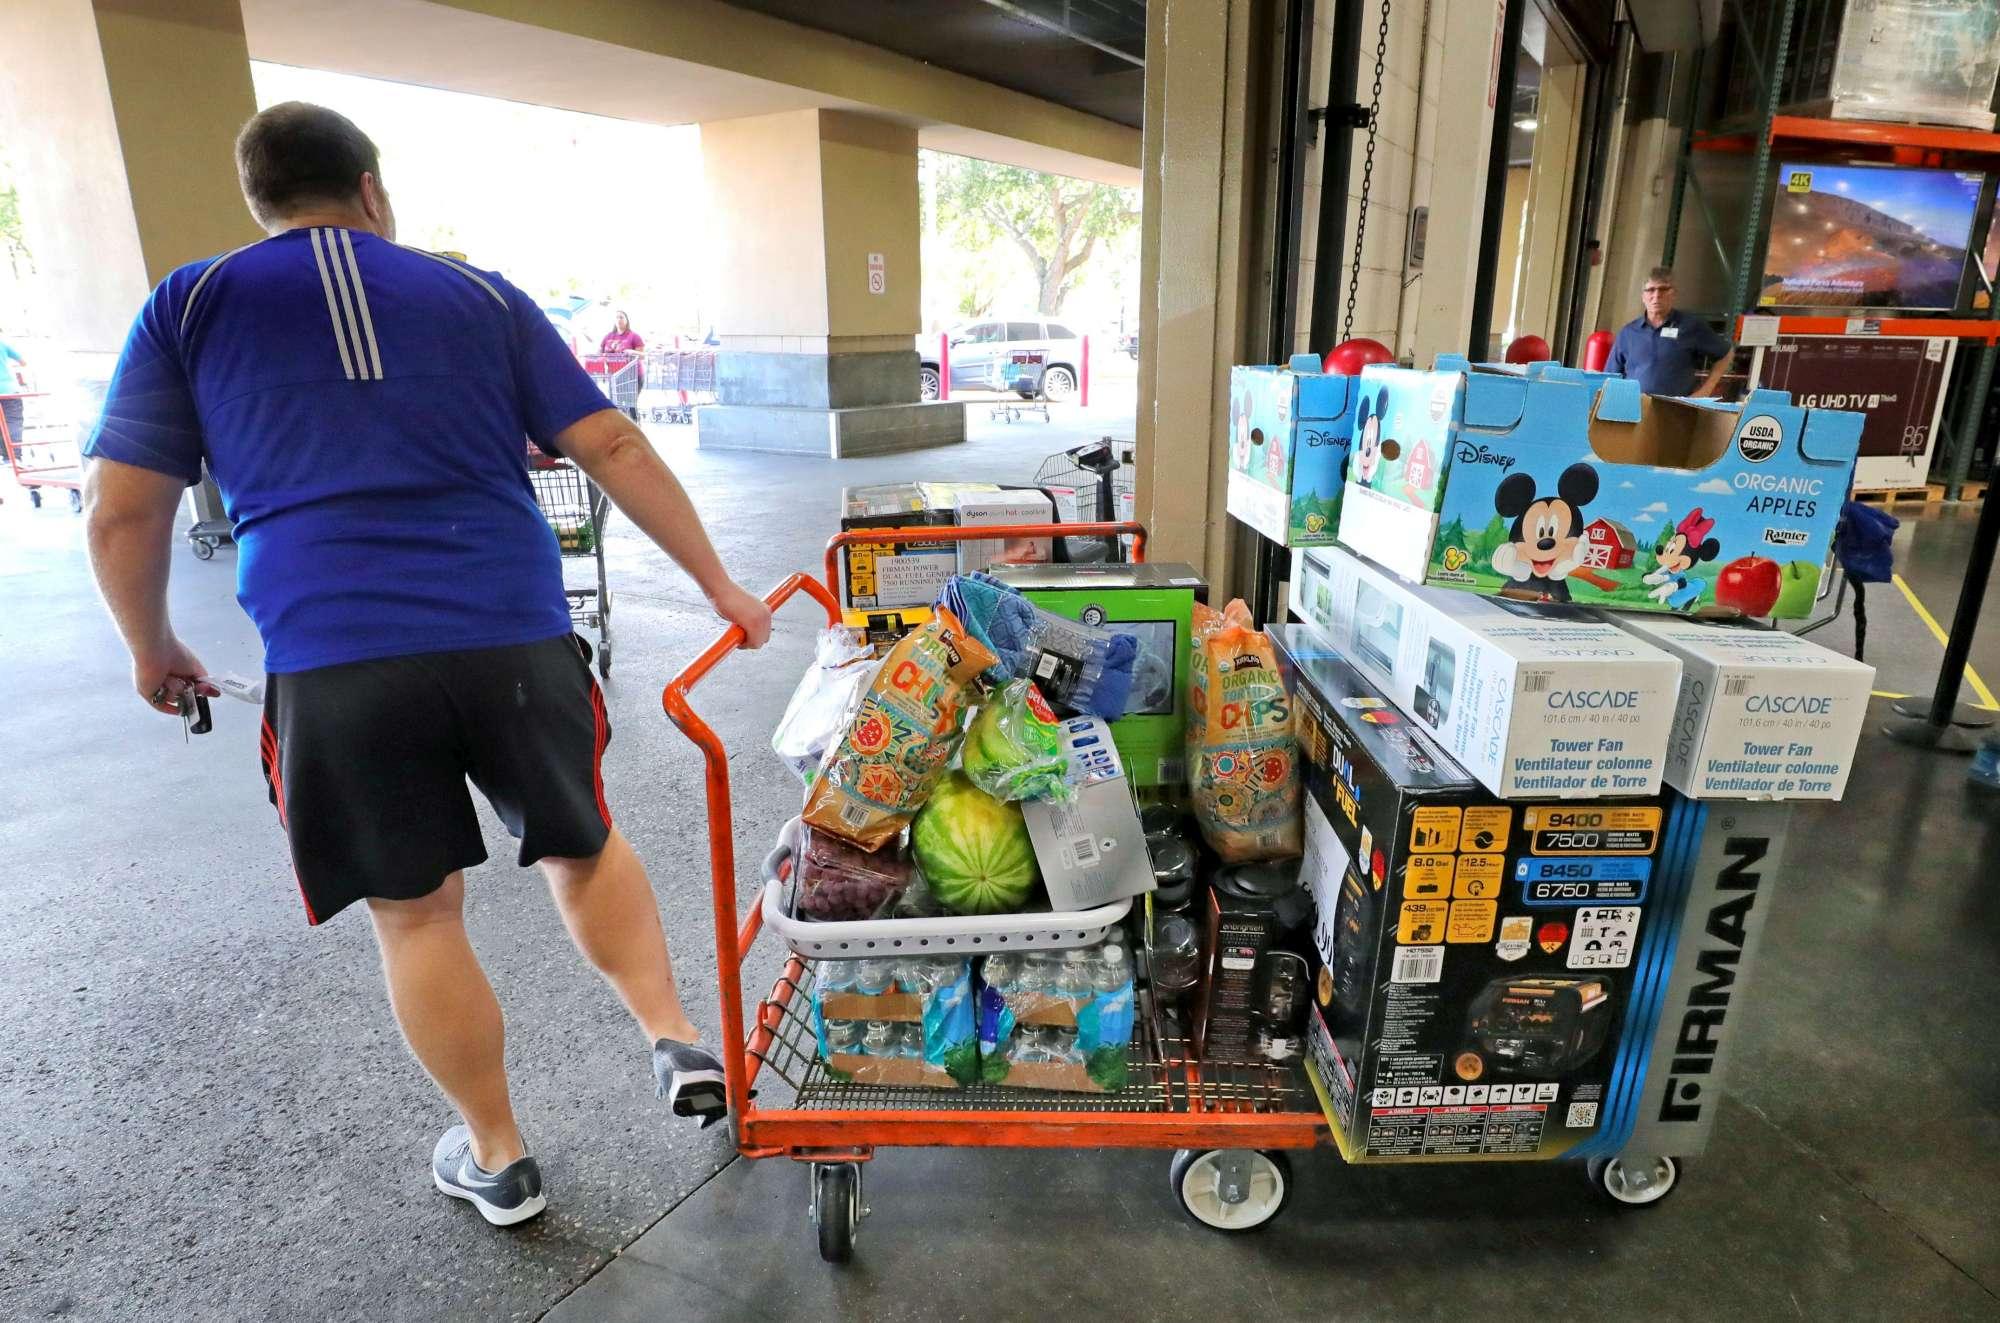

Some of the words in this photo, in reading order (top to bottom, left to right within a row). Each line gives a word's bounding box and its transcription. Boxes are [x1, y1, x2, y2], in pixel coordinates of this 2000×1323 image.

[1791, 173, 1811, 186] 4K
[1799, 394, 1817, 408] LG
[1820, 394, 1847, 408] UHD
[1849, 394, 1867, 408] TV
[1749, 426, 1774, 438] USDA
[1742, 439, 1775, 451] ORGANIC
[1734, 472, 1824, 496] ORGANIC
[966, 509, 988, 519] dyson
[1746, 495, 1817, 518] APPLES
[1764, 528, 1808, 542] Rainier
[1222, 669, 1278, 689] ORGANIC
[1547, 689, 1639, 709] CASCADE
[1745, 694, 1832, 714] CASCADE
[1487, 677, 1507, 768] CASCADE
[1568, 714, 1581, 723] cm
[1589, 714, 1600, 723] 40
[1617, 714, 1628, 723] 40
[1675, 680, 1704, 767] CASCADE
[1550, 738, 1592, 752] Tower
[1597, 738, 1623, 752] Fan
[1743, 741, 1784, 756] Tower
[1787, 742, 1813, 756] Fan
[1332, 744, 1355, 794] DUAL
[1514, 757, 1591, 771] Ventilateur
[1596, 757, 1653, 770] colonne
[1707, 759, 1781, 774] Ventilateur
[1785, 761, 1839, 775] colonne
[1513, 776, 1585, 789] Ventilador
[1590, 775, 1607, 788] de
[1612, 774, 1647, 788] Torre
[1705, 777, 1773, 791] Ventilador
[1777, 778, 1794, 791] de
[1799, 778, 1832, 792] Torre
[1336, 785, 1358, 829] FUEL
[1548, 813, 1603, 827] 9400
[1546, 833, 1599, 848] 7500
[1540, 864, 1593, 877] 8450
[1536, 883, 1590, 897] 6750
[1403, 904, 1426, 913] 439
[1657, 837, 1770, 1122] FIRMAN
